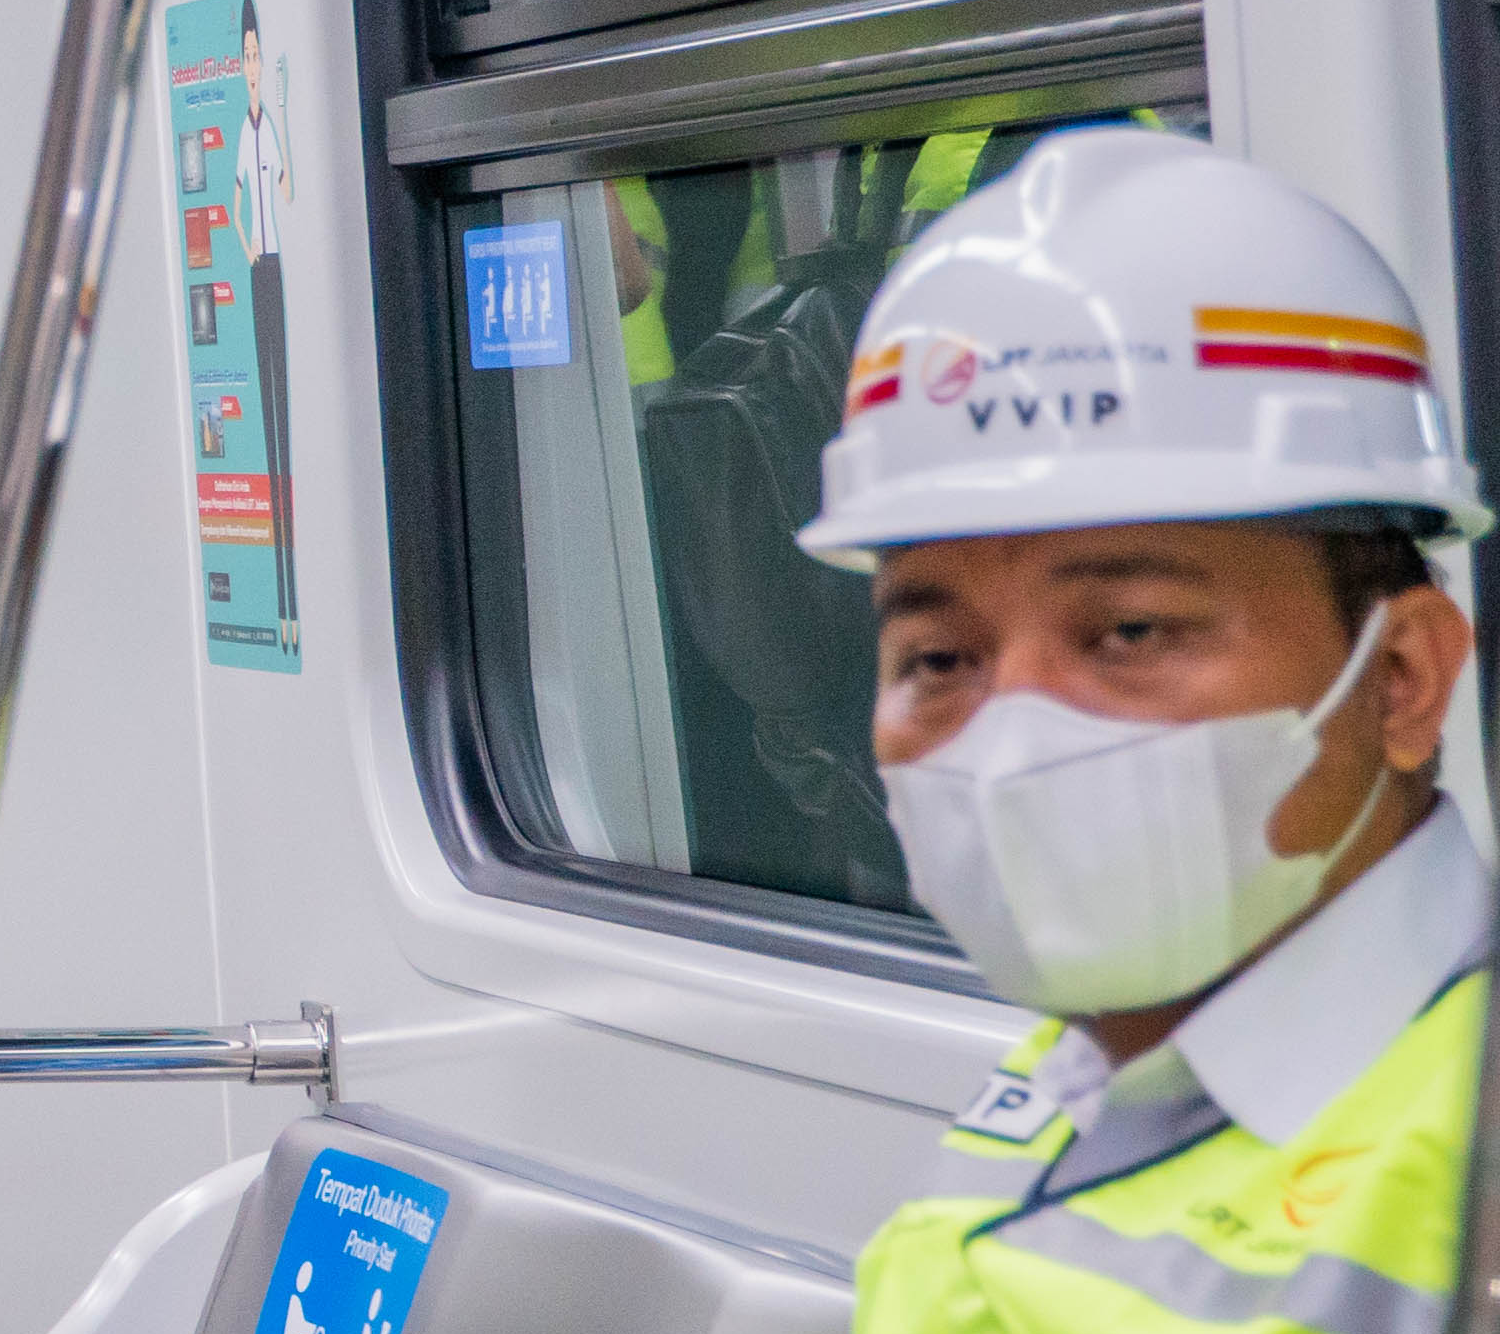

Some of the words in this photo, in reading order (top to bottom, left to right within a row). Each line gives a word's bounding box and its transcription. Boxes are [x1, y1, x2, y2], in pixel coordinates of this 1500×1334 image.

[1039, 341, 1169, 366] JAKATA
[966, 390, 1123, 432] VVIP
[314, 1168, 368, 1217] Tempat
[364, 1185, 403, 1230] Duduk
[401, 1197, 435, 1244] Prioritas
[343, 1229, 382, 1271] Priority
[376, 1241, 398, 1272] Seat
